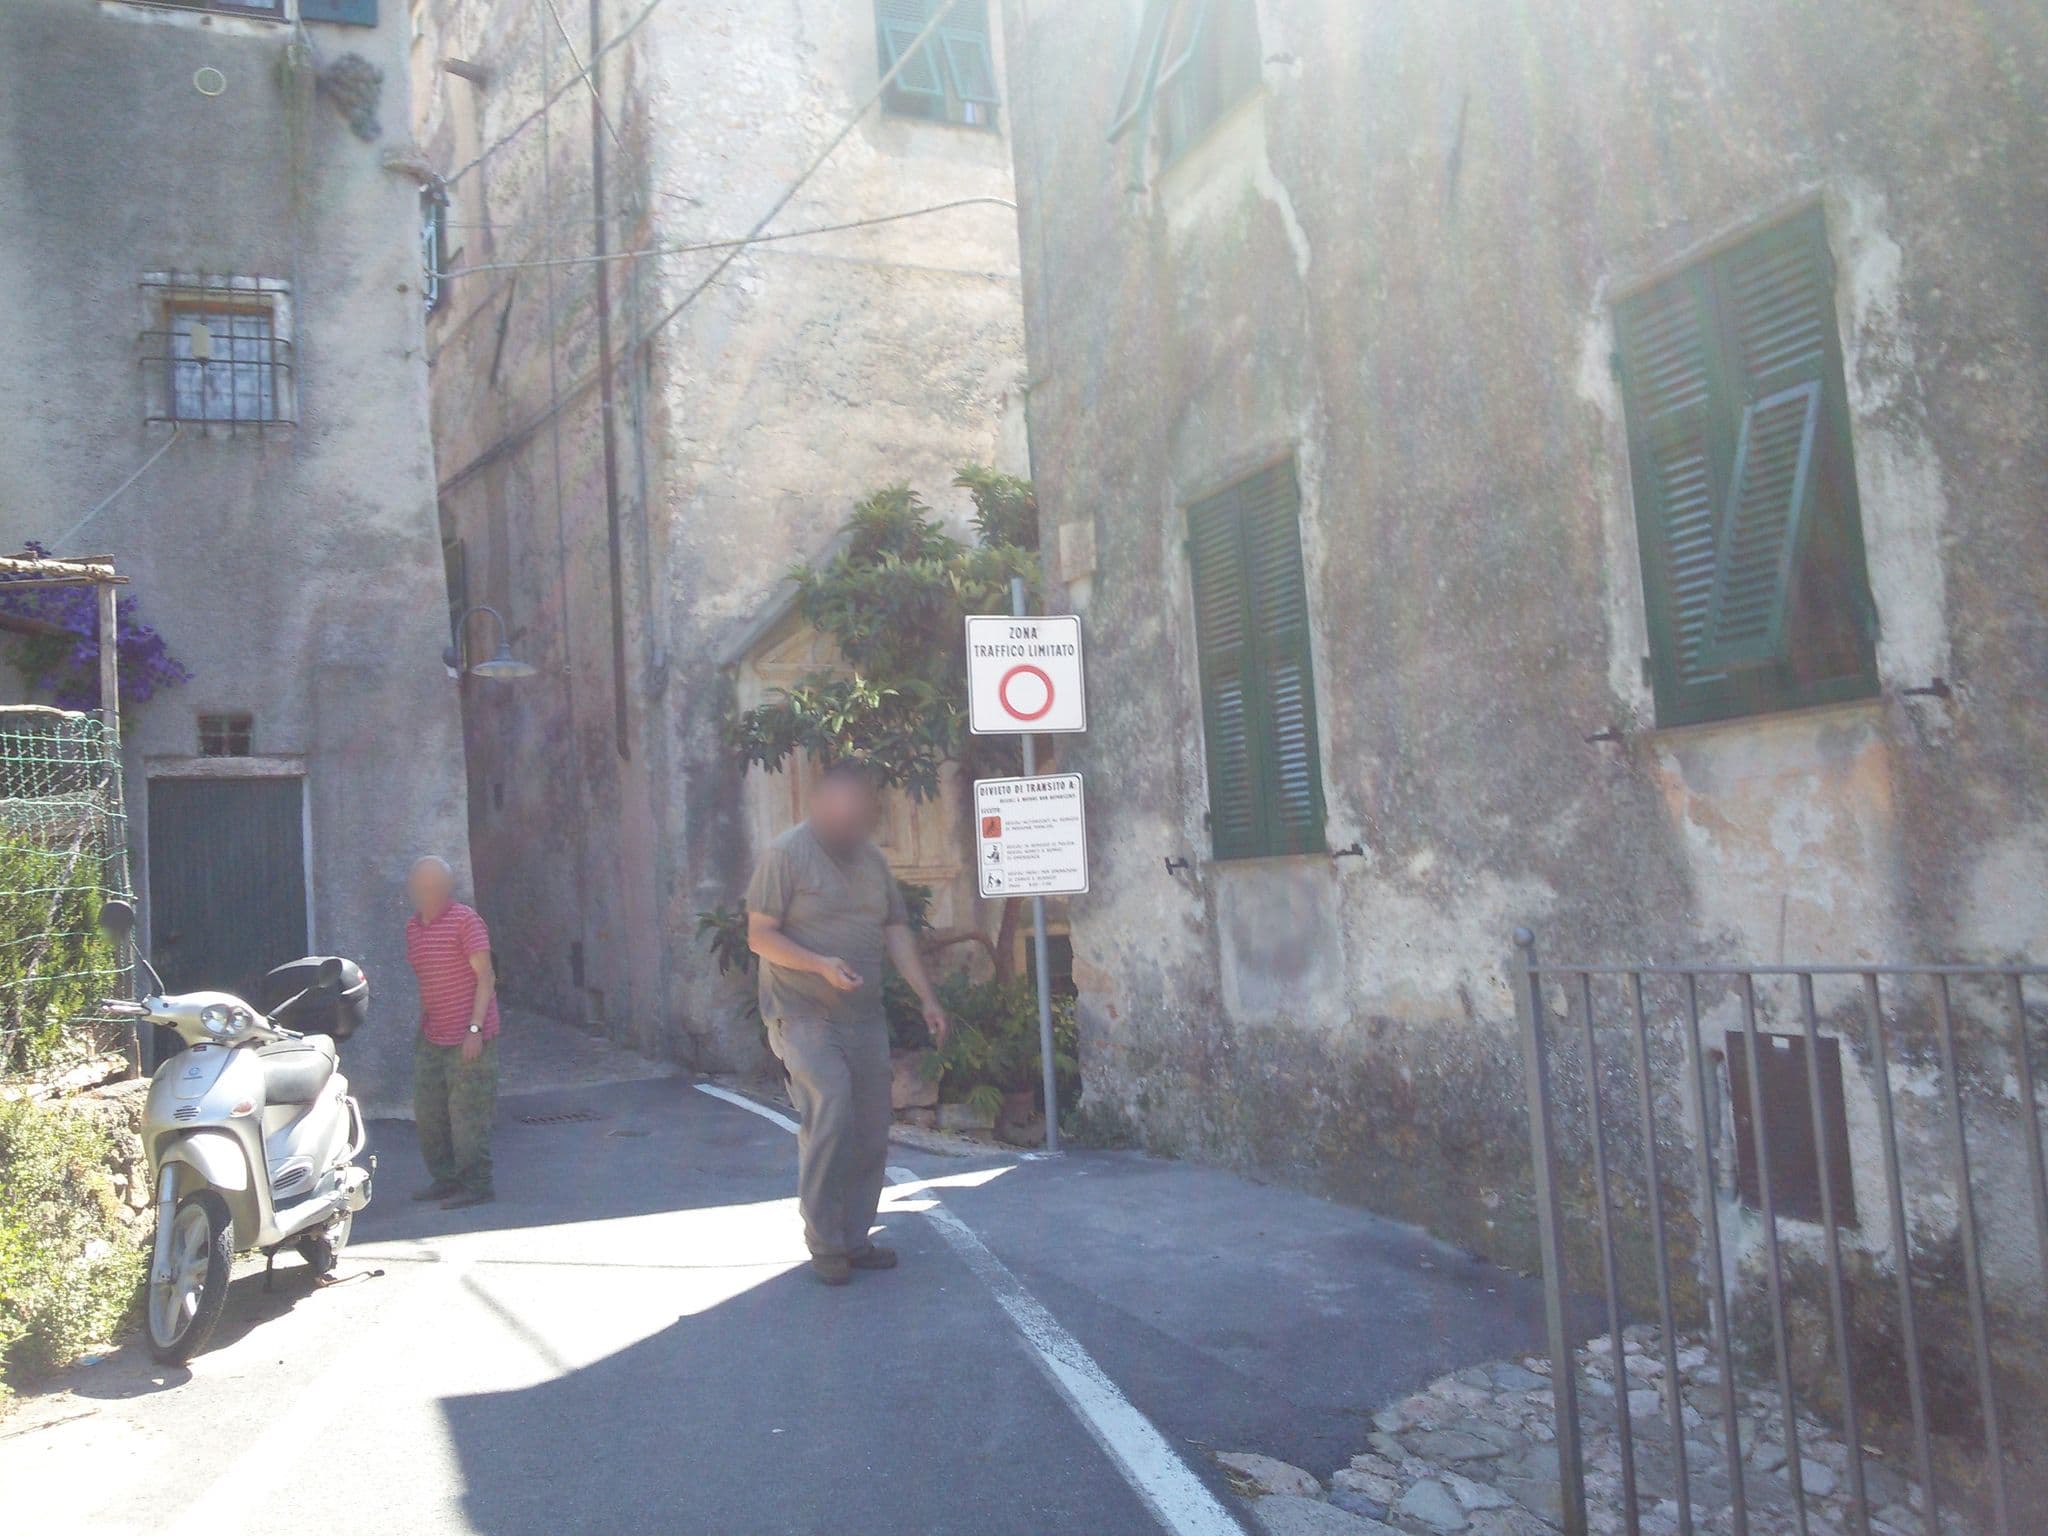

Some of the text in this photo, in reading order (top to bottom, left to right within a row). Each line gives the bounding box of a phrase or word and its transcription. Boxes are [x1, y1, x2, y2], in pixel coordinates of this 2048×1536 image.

[1009, 626, 1038, 639] ZONA
[974, 644, 1075, 657] TRAFFICO LIMITATO
[980, 785, 1012, 797] DIVIETO
[1015, 784, 1024, 794] DI
[1026, 781, 1066, 793] TRANSITO
